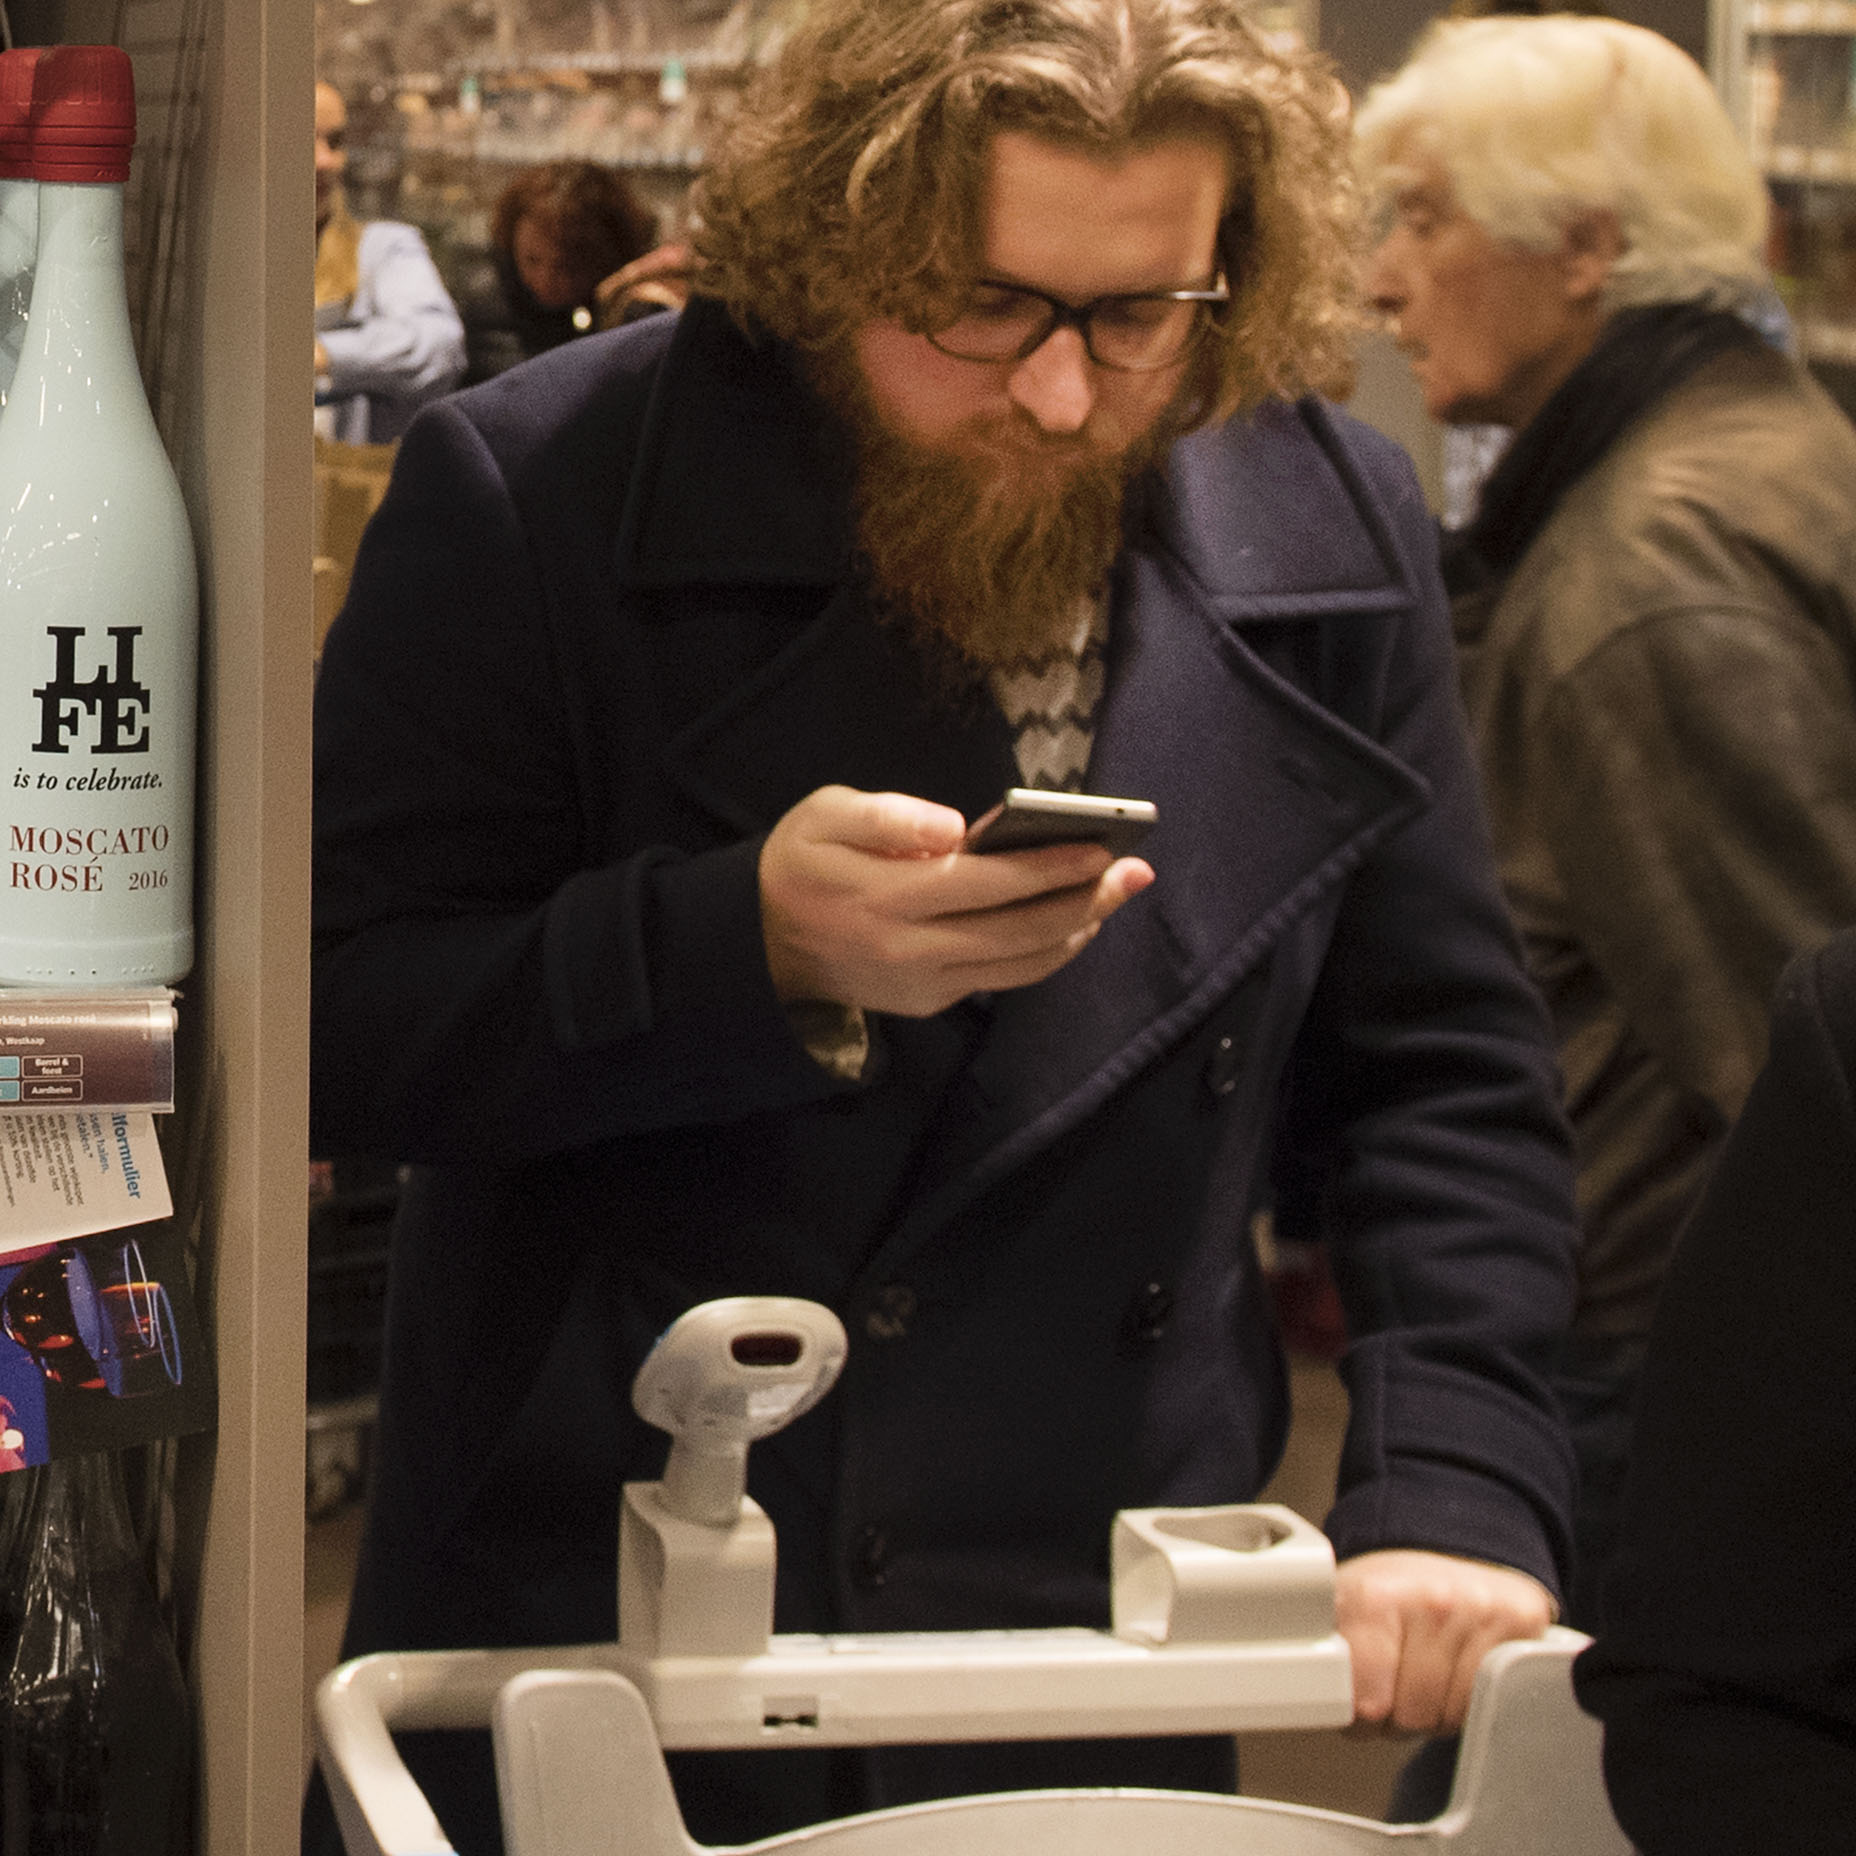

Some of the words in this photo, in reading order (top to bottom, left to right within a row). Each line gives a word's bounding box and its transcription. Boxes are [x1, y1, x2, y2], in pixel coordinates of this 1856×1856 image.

[13, 768, 30, 789] is
[38, 771, 58, 790] to
[66, 769, 163, 791] celebrate.
[10, 825, 169, 856] MOSCATO
[10, 858, 103, 892] ROSÉ
[128, 868, 168, 891] 2016
